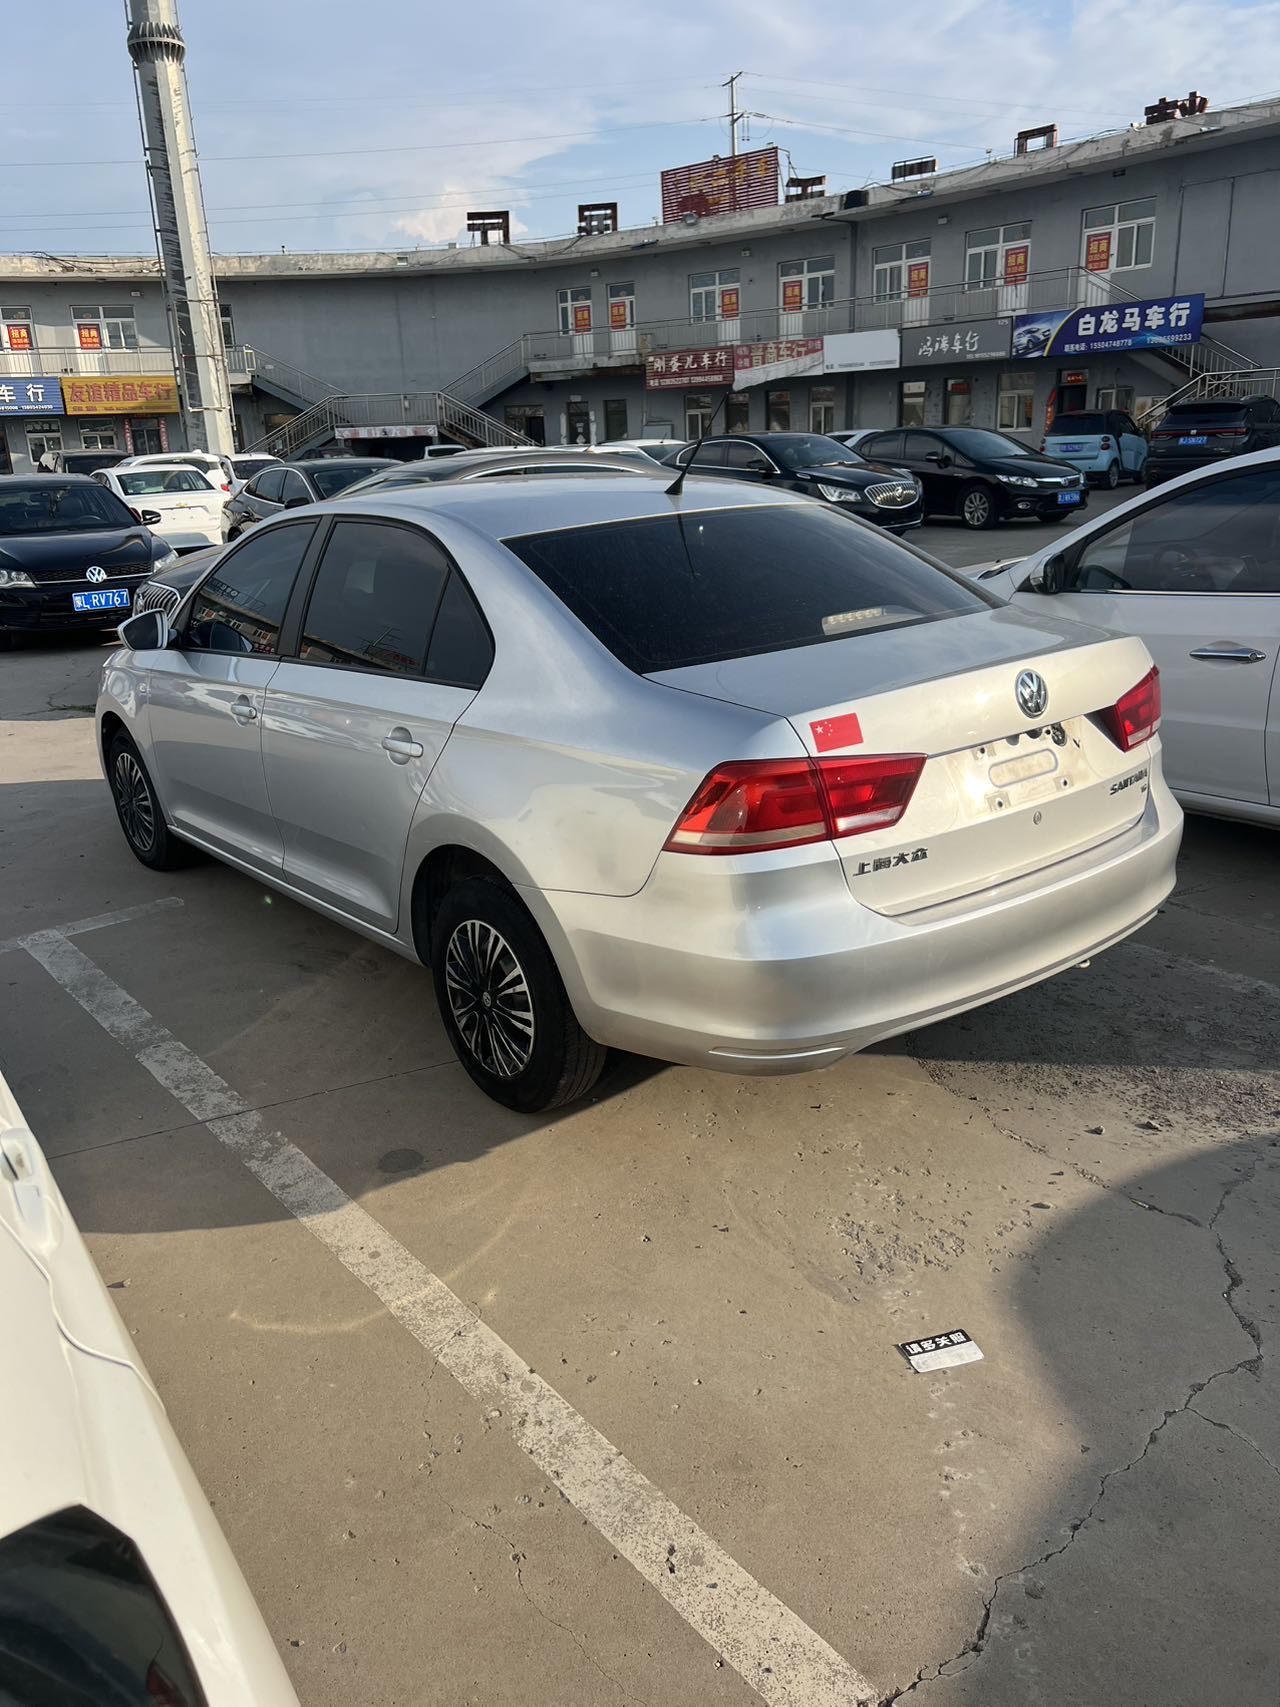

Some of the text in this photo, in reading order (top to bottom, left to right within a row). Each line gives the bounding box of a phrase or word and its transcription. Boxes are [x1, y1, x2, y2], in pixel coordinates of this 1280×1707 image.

[1077, 302, 1192, 336] 白龙马车行
[11, 328, 28, 338] 招商
[852, 847, 929, 877] 上海大众
[905, 1331, 967, 1354] 请多关照
